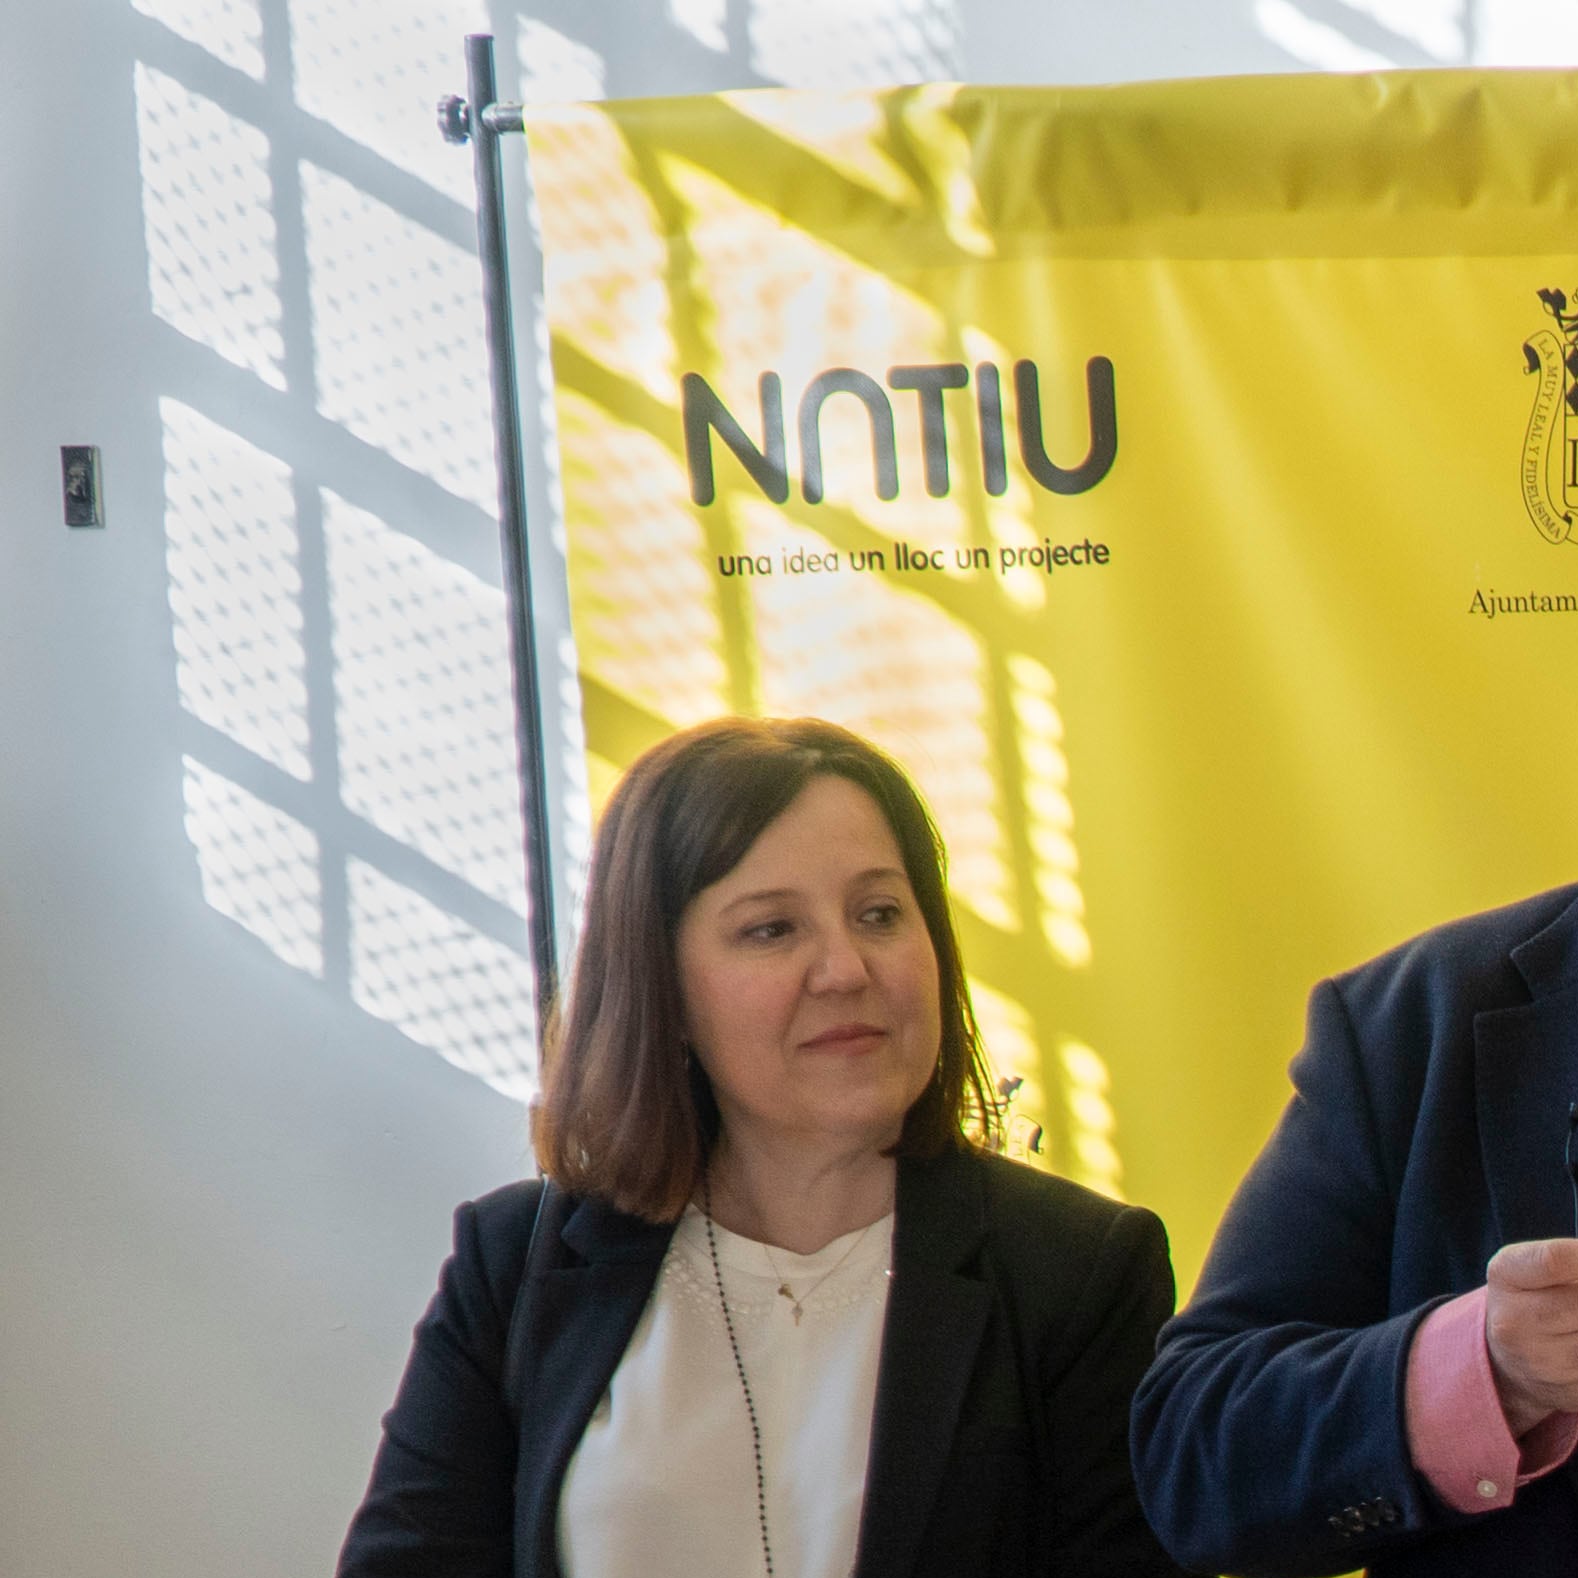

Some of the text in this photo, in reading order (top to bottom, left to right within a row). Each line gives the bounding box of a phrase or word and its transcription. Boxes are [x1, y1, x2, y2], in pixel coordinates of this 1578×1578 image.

[718, 538, 1110, 576] una idea un lloc un projecte
